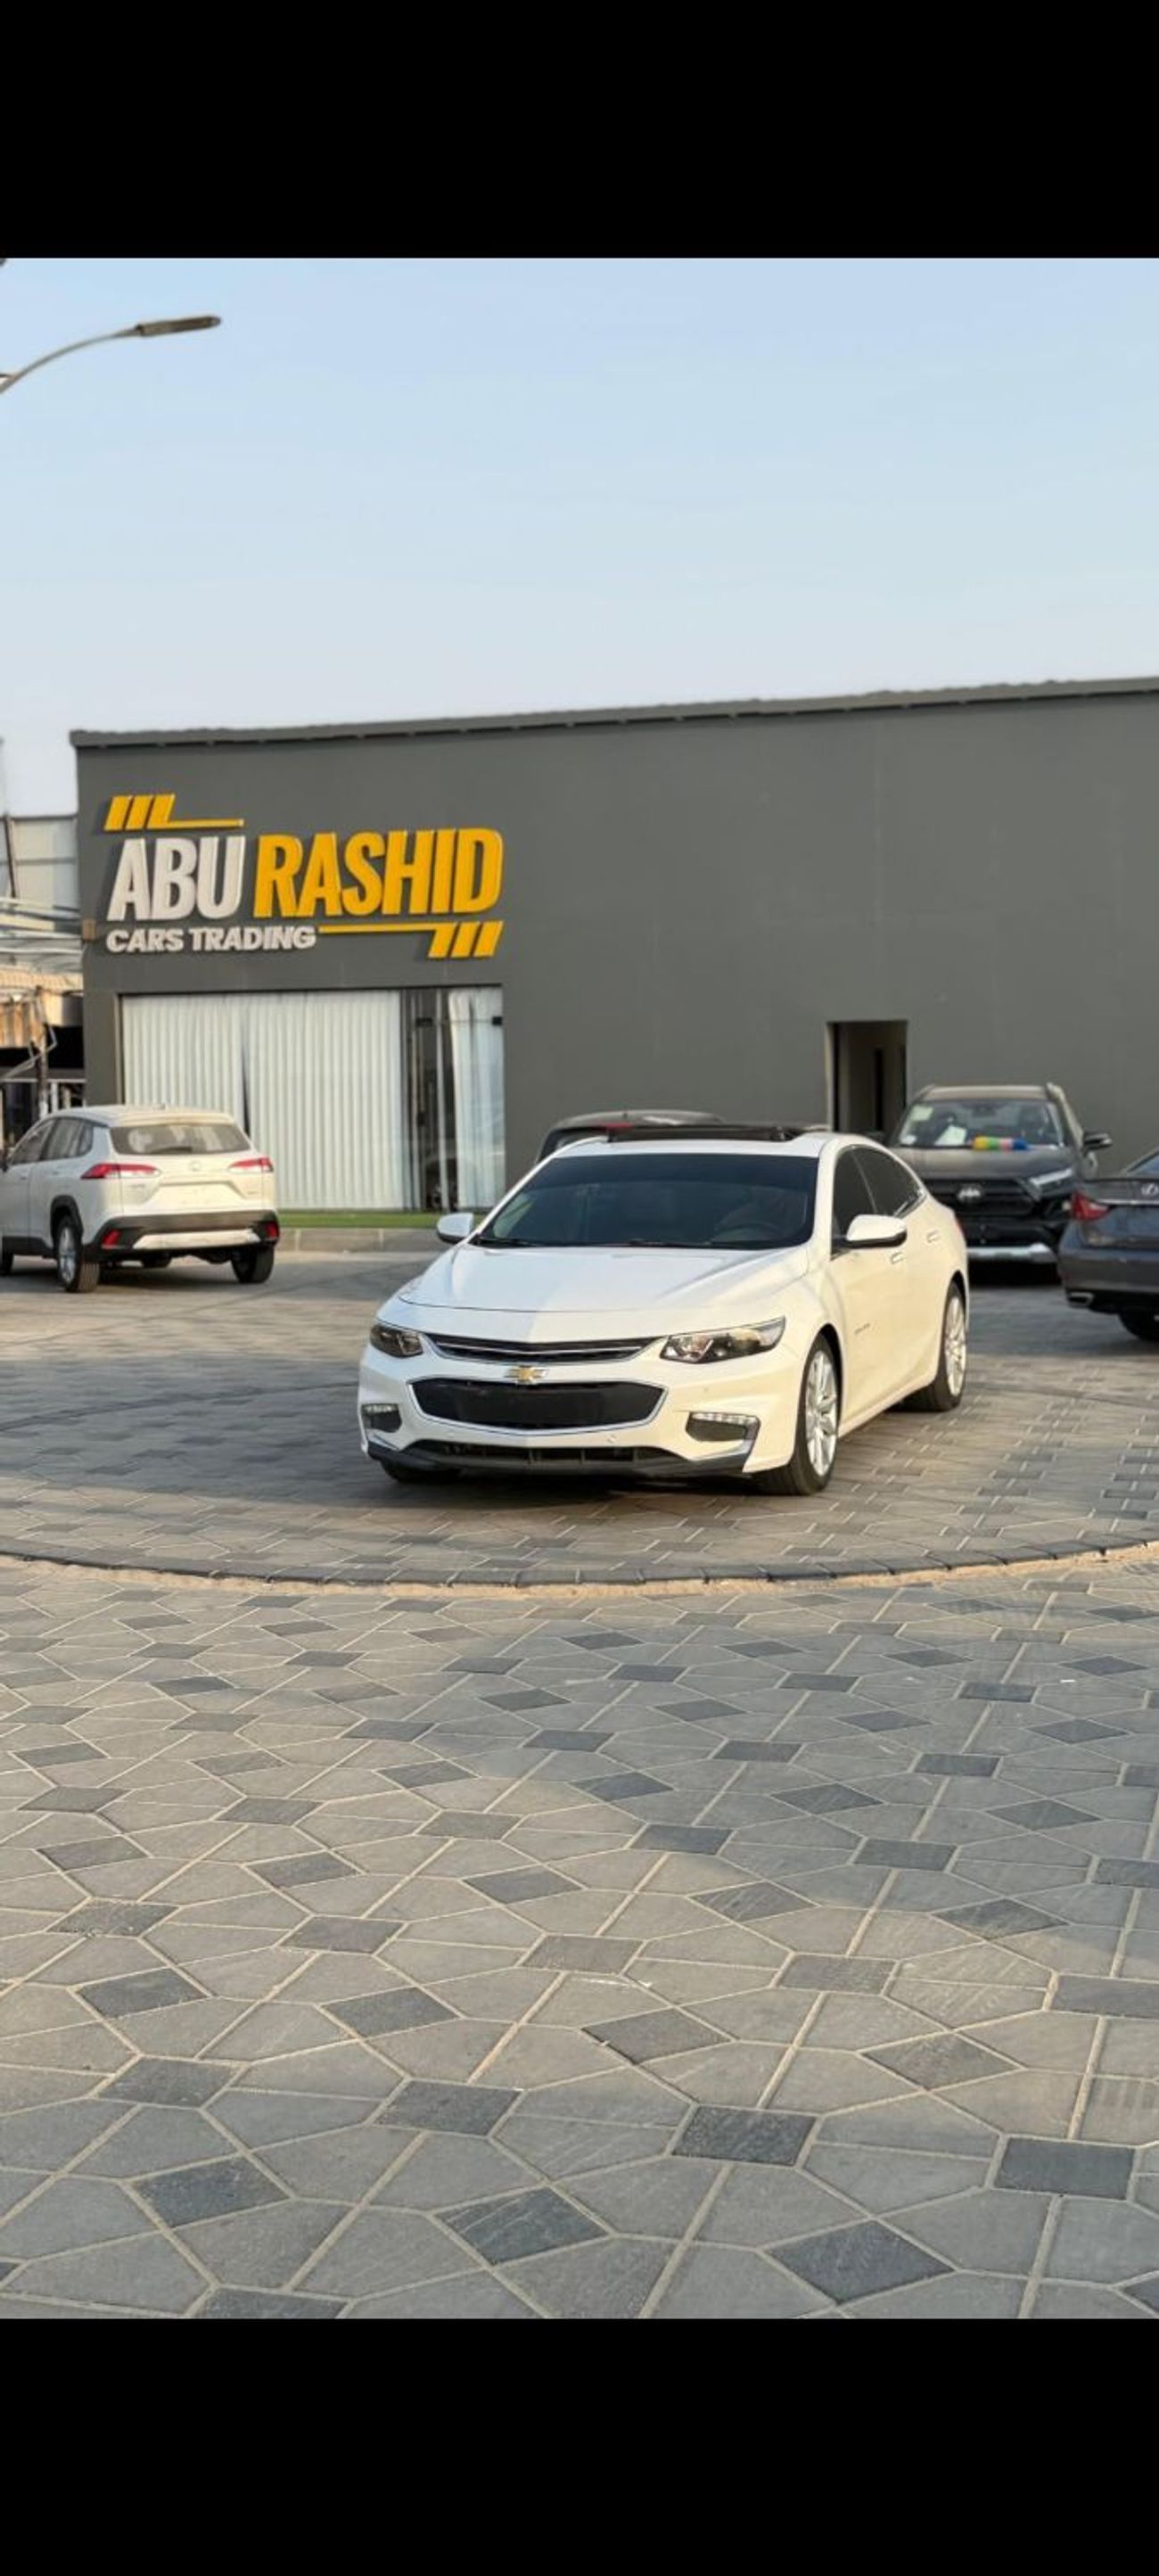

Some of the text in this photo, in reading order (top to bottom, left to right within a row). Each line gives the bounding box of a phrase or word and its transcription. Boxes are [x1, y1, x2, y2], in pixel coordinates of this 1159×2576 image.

[106, 827, 505, 921] ABU RASHID
[106, 925, 316, 952] CARS TRADING
